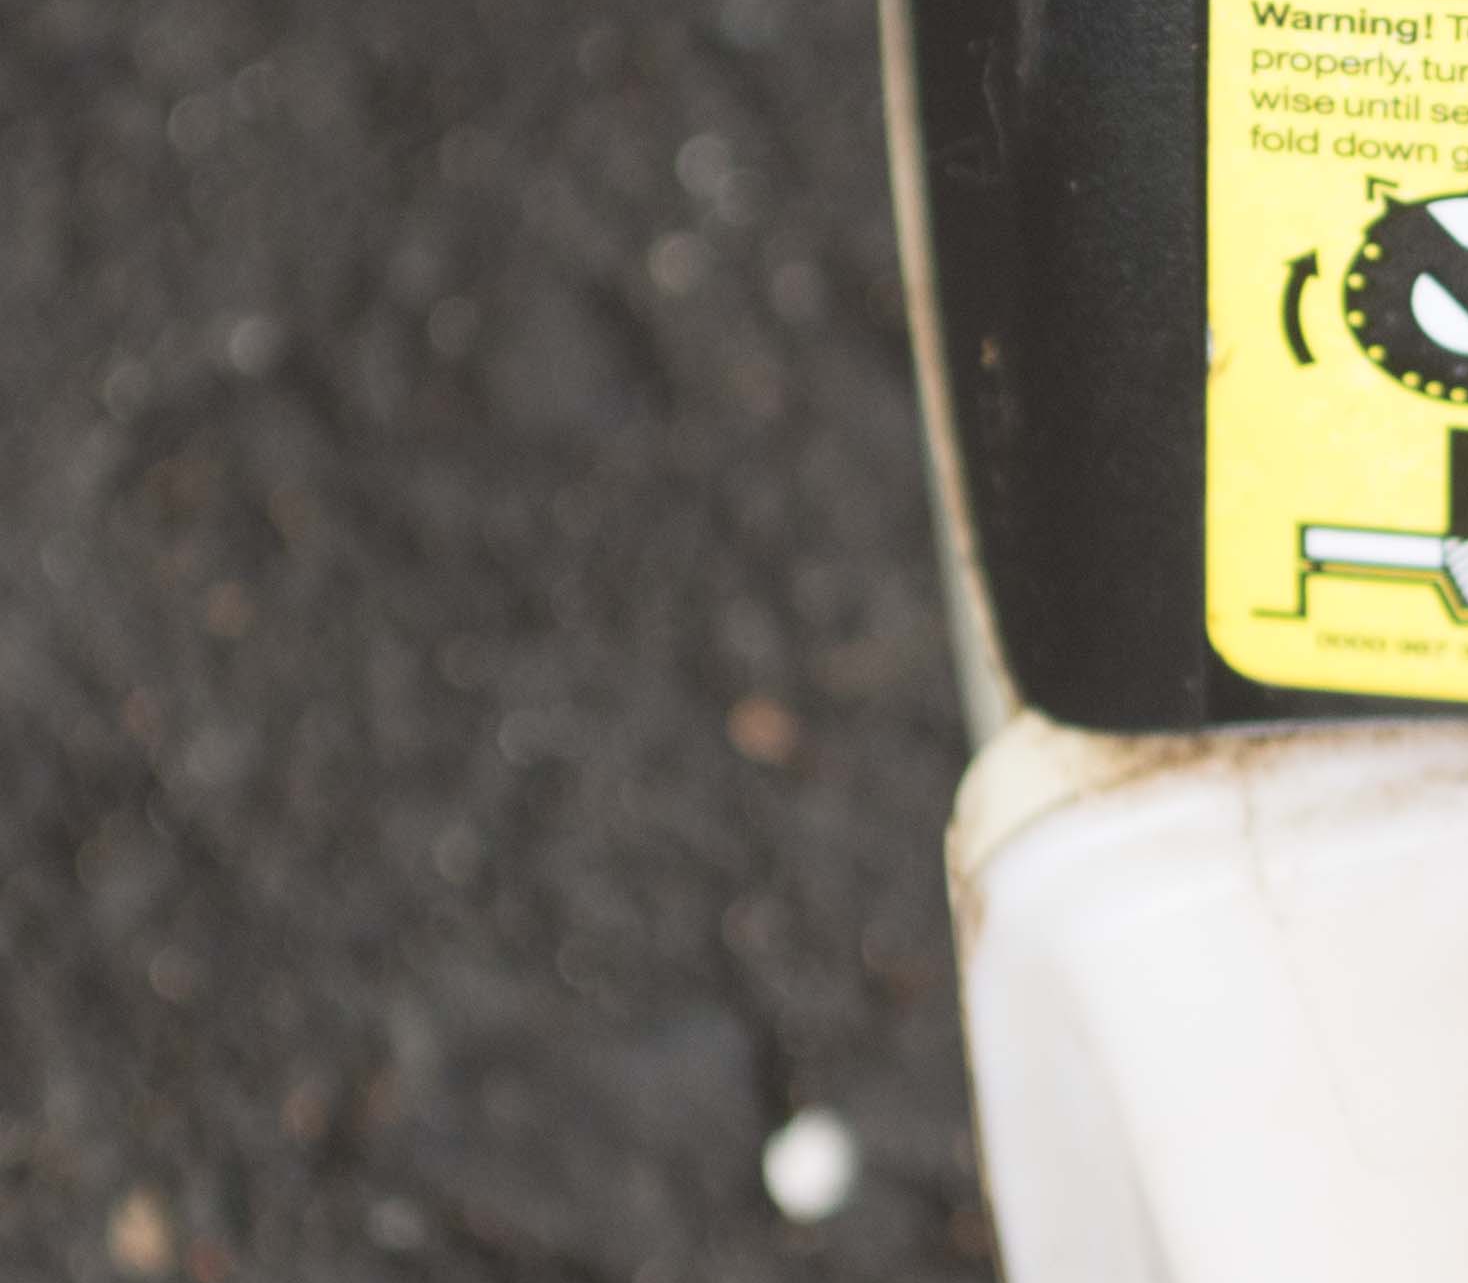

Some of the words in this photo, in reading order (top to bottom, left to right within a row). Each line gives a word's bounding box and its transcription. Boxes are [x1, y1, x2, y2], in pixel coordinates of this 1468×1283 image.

[1250, 0, 1433, 45] Warning!
[1251, 49, 1412, 85] properly,
[1250, 86, 1335, 116] wise
[1343, 94, 1420, 121] until
[1250, 123, 1320, 156] fold
[1332, 132, 1438, 163] down
